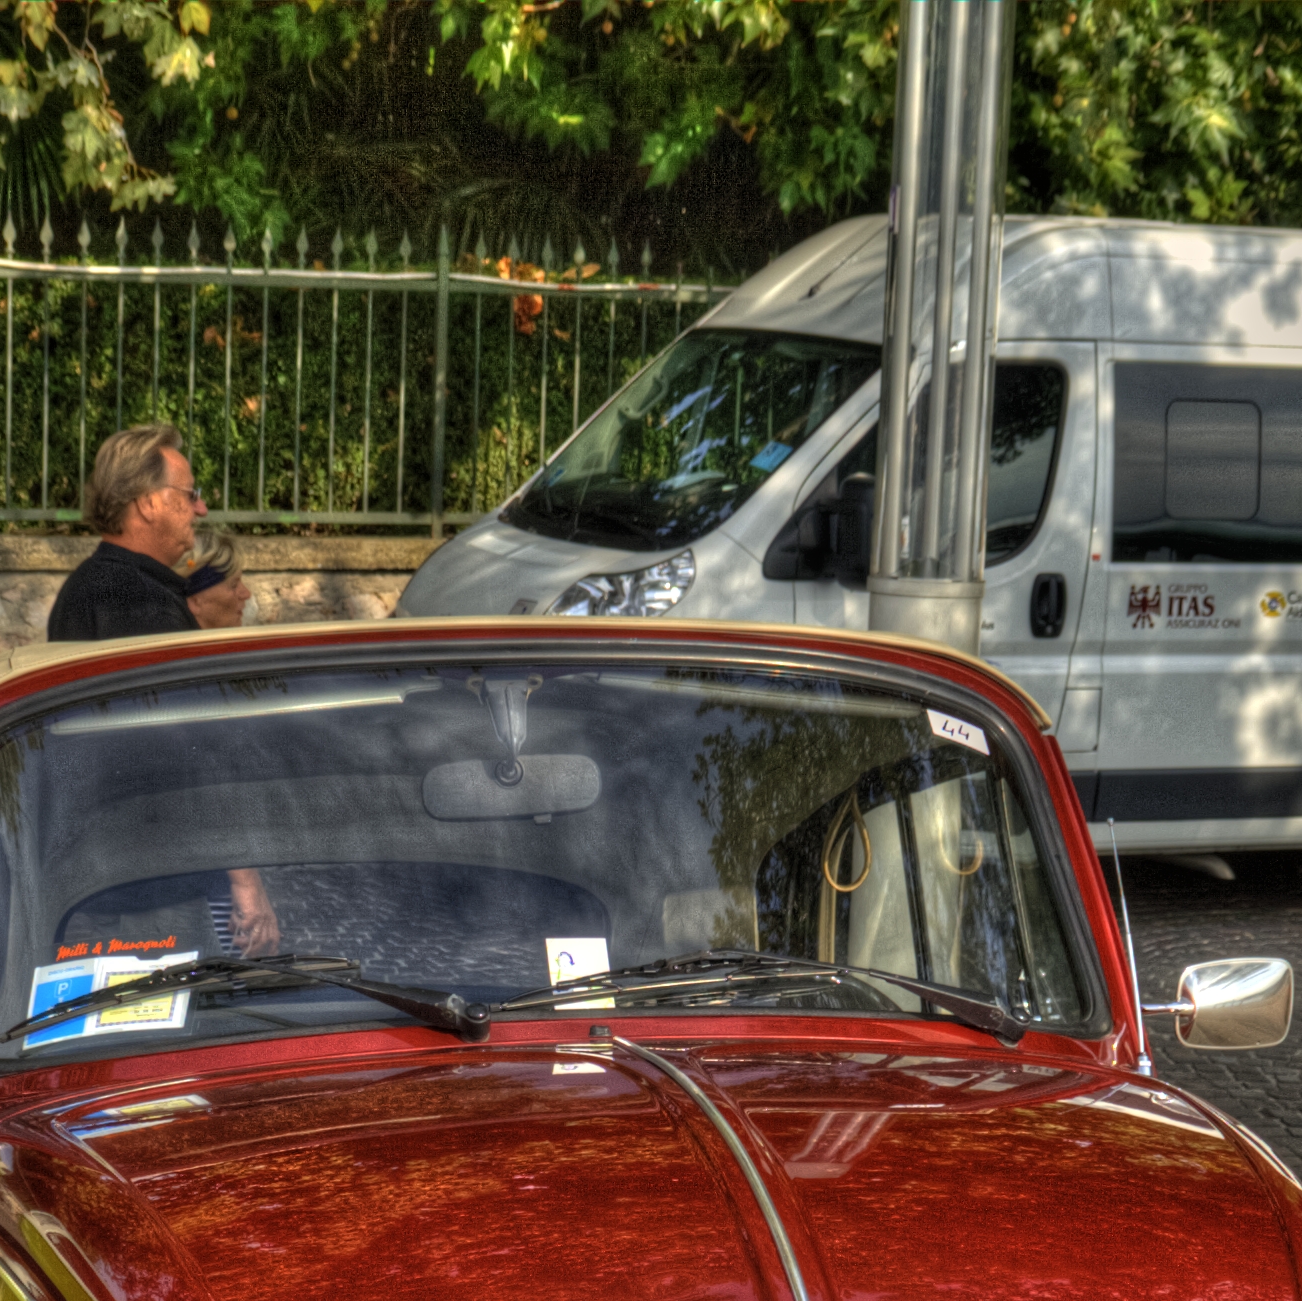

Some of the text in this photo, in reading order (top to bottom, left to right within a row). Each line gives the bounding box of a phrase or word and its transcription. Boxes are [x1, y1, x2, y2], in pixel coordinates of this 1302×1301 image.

[1167, 583, 1209, 594] GRUPPO
[1166, 595, 1216, 617] ITAS
[941, 719, 970, 741] 44
